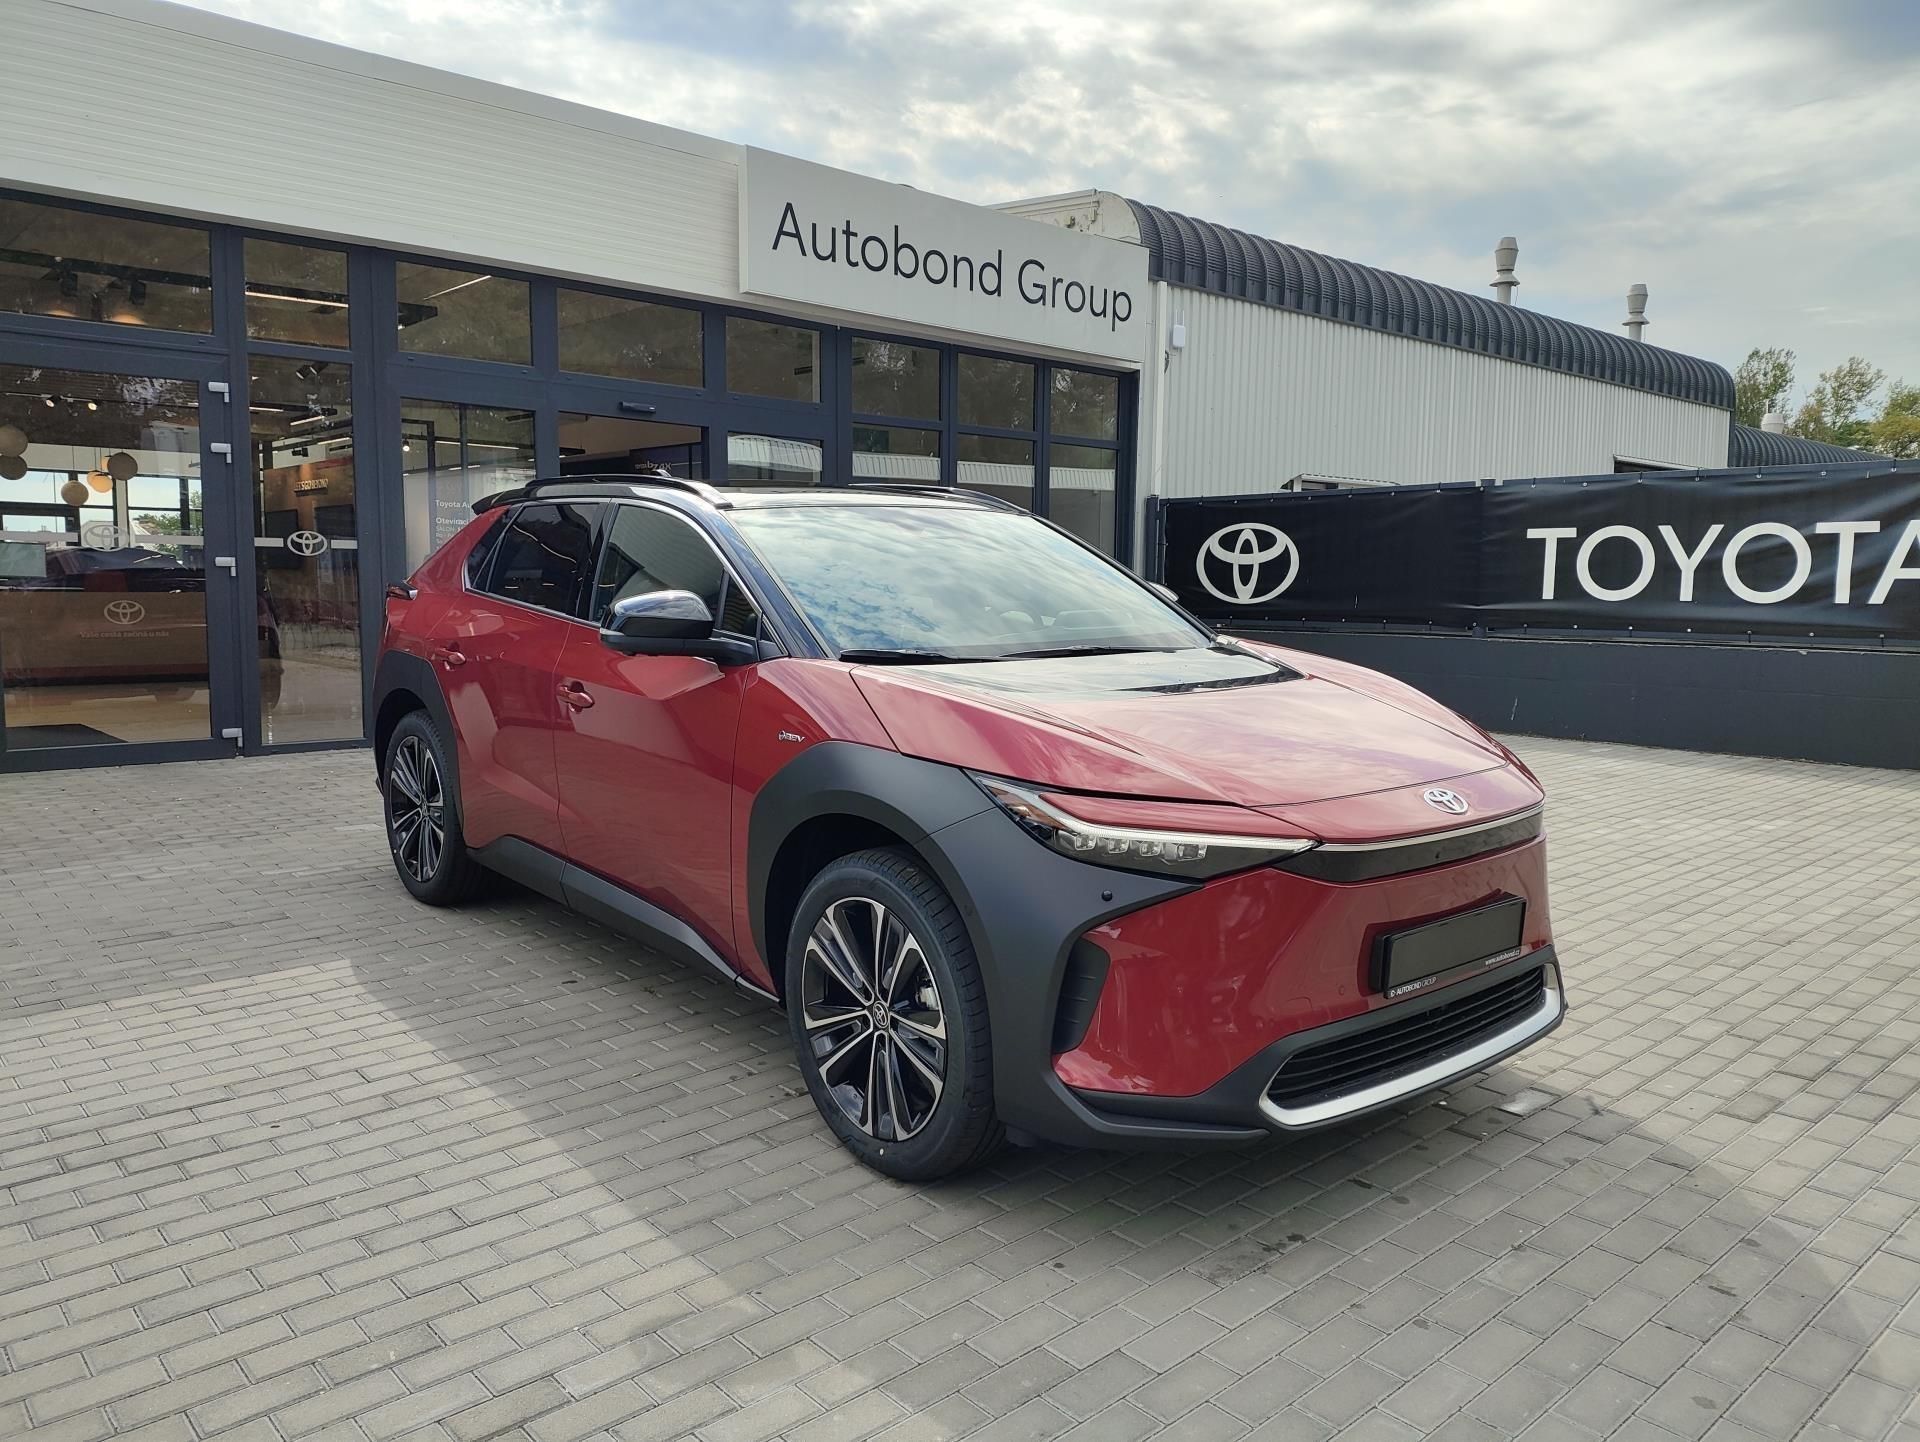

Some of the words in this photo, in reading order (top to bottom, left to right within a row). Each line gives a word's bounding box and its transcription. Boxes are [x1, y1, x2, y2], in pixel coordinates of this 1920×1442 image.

[772, 202, 1002, 297] Autobond
[1018, 259, 1132, 331] Group
[436, 500, 460, 508] Toyota
[1527, 520, 1920, 605] TOYOTA
